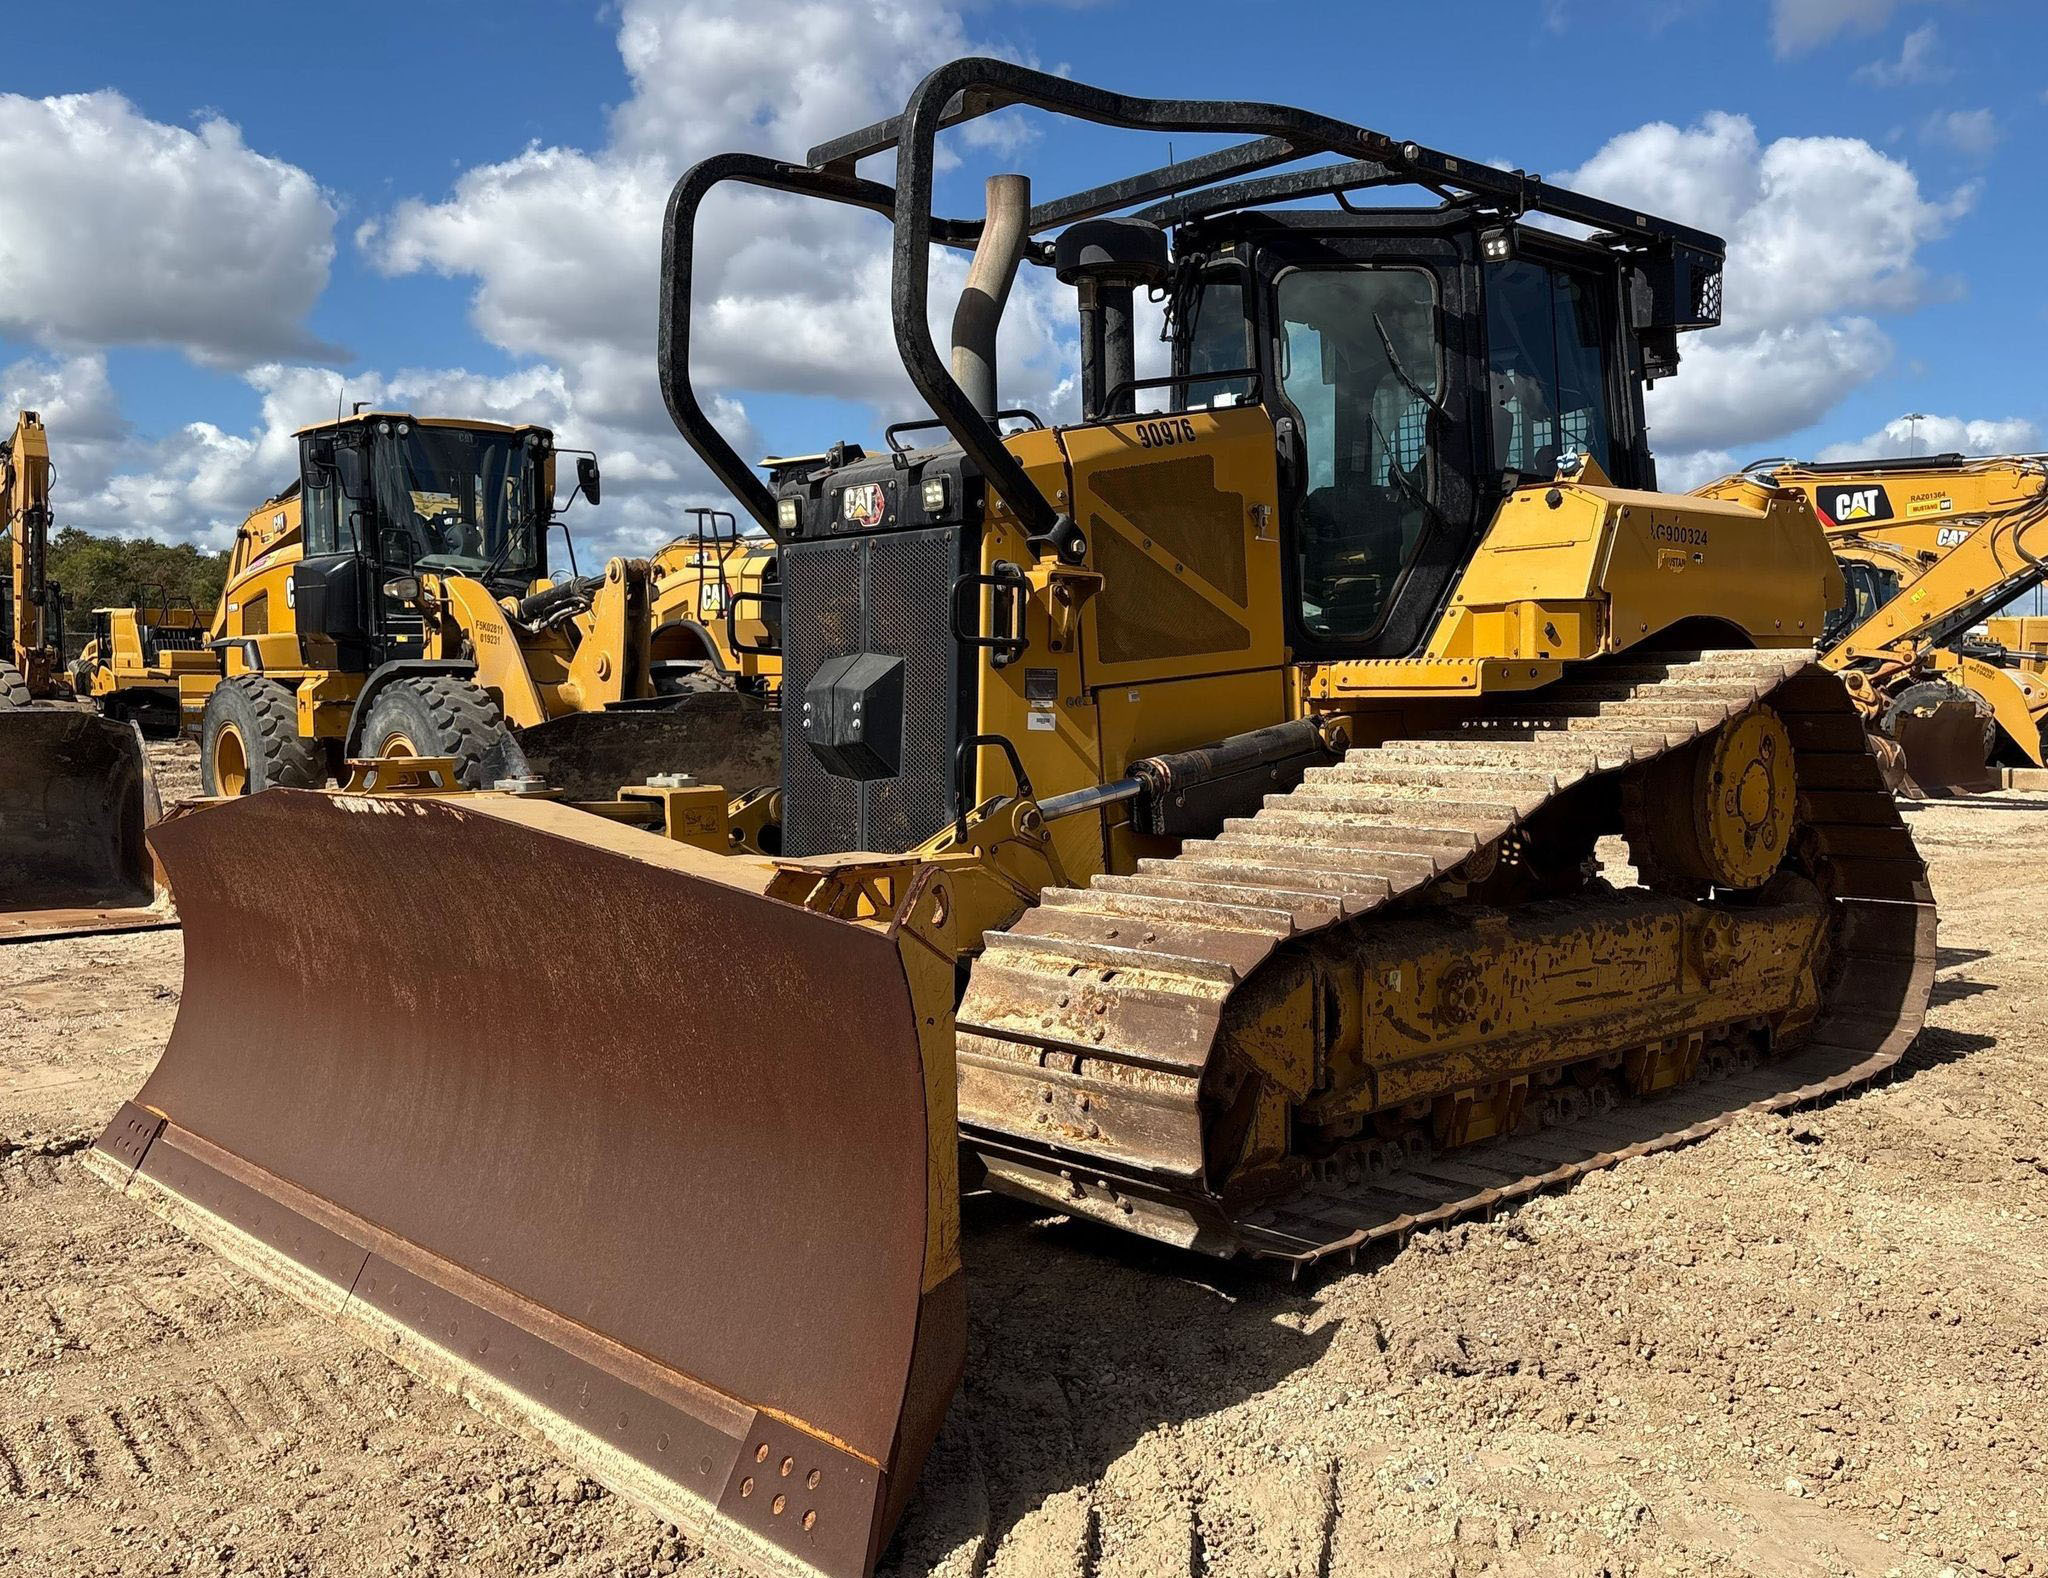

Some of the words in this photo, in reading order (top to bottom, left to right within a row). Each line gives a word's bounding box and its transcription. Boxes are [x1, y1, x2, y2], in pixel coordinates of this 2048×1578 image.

[458, 431, 474, 445] CAT
[1136, 418, 1196, 448] 90976
[845, 486, 874, 519] CAT
[1836, 489, 1879, 521] CAT
[480, 633, 500, 646] 019231
